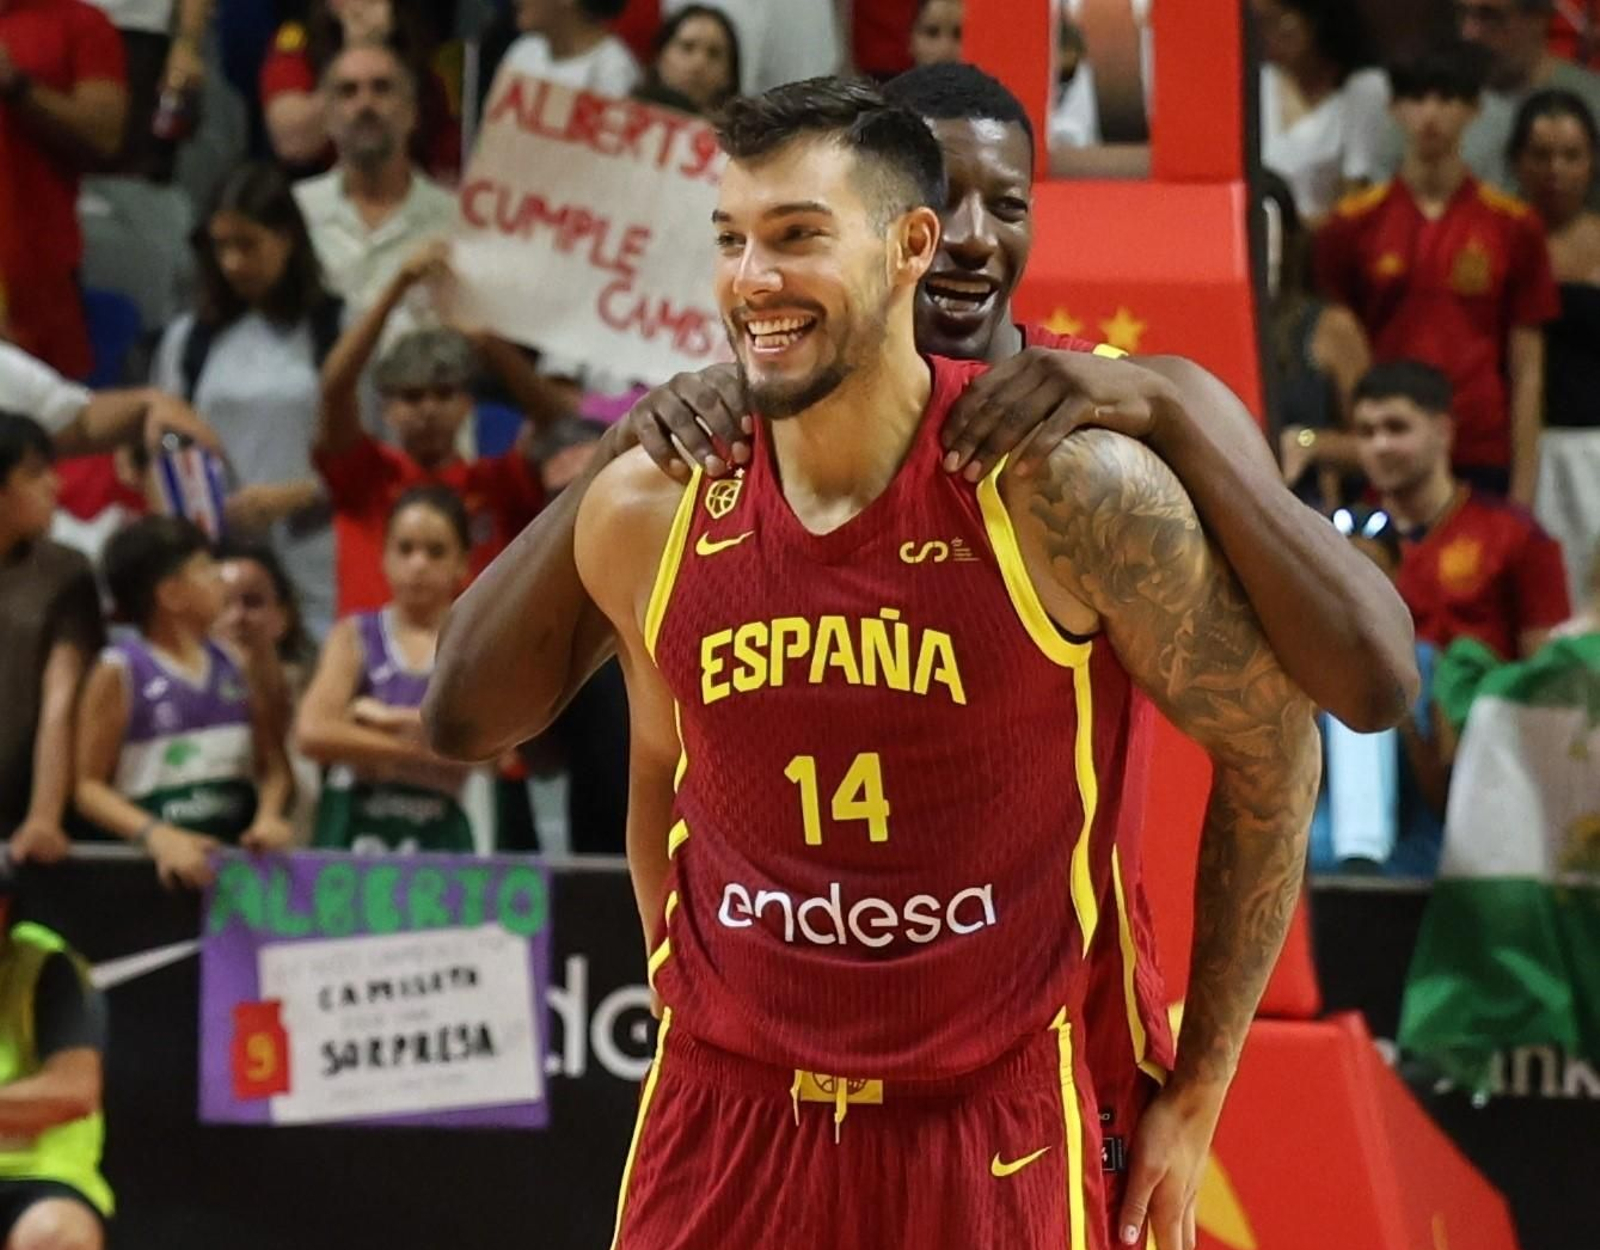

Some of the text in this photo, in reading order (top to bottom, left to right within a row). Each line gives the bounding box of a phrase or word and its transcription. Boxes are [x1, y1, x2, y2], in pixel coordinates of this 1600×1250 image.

[461, 180, 652, 281] CUMPLE
[701, 607, 967, 705] ESPAÑA
[783, 752, 890, 845] 14
[209, 861, 546, 937] ALBERTO
[718, 882, 996, 947] endesa
[321, 1022, 497, 1077] SORPRESA
